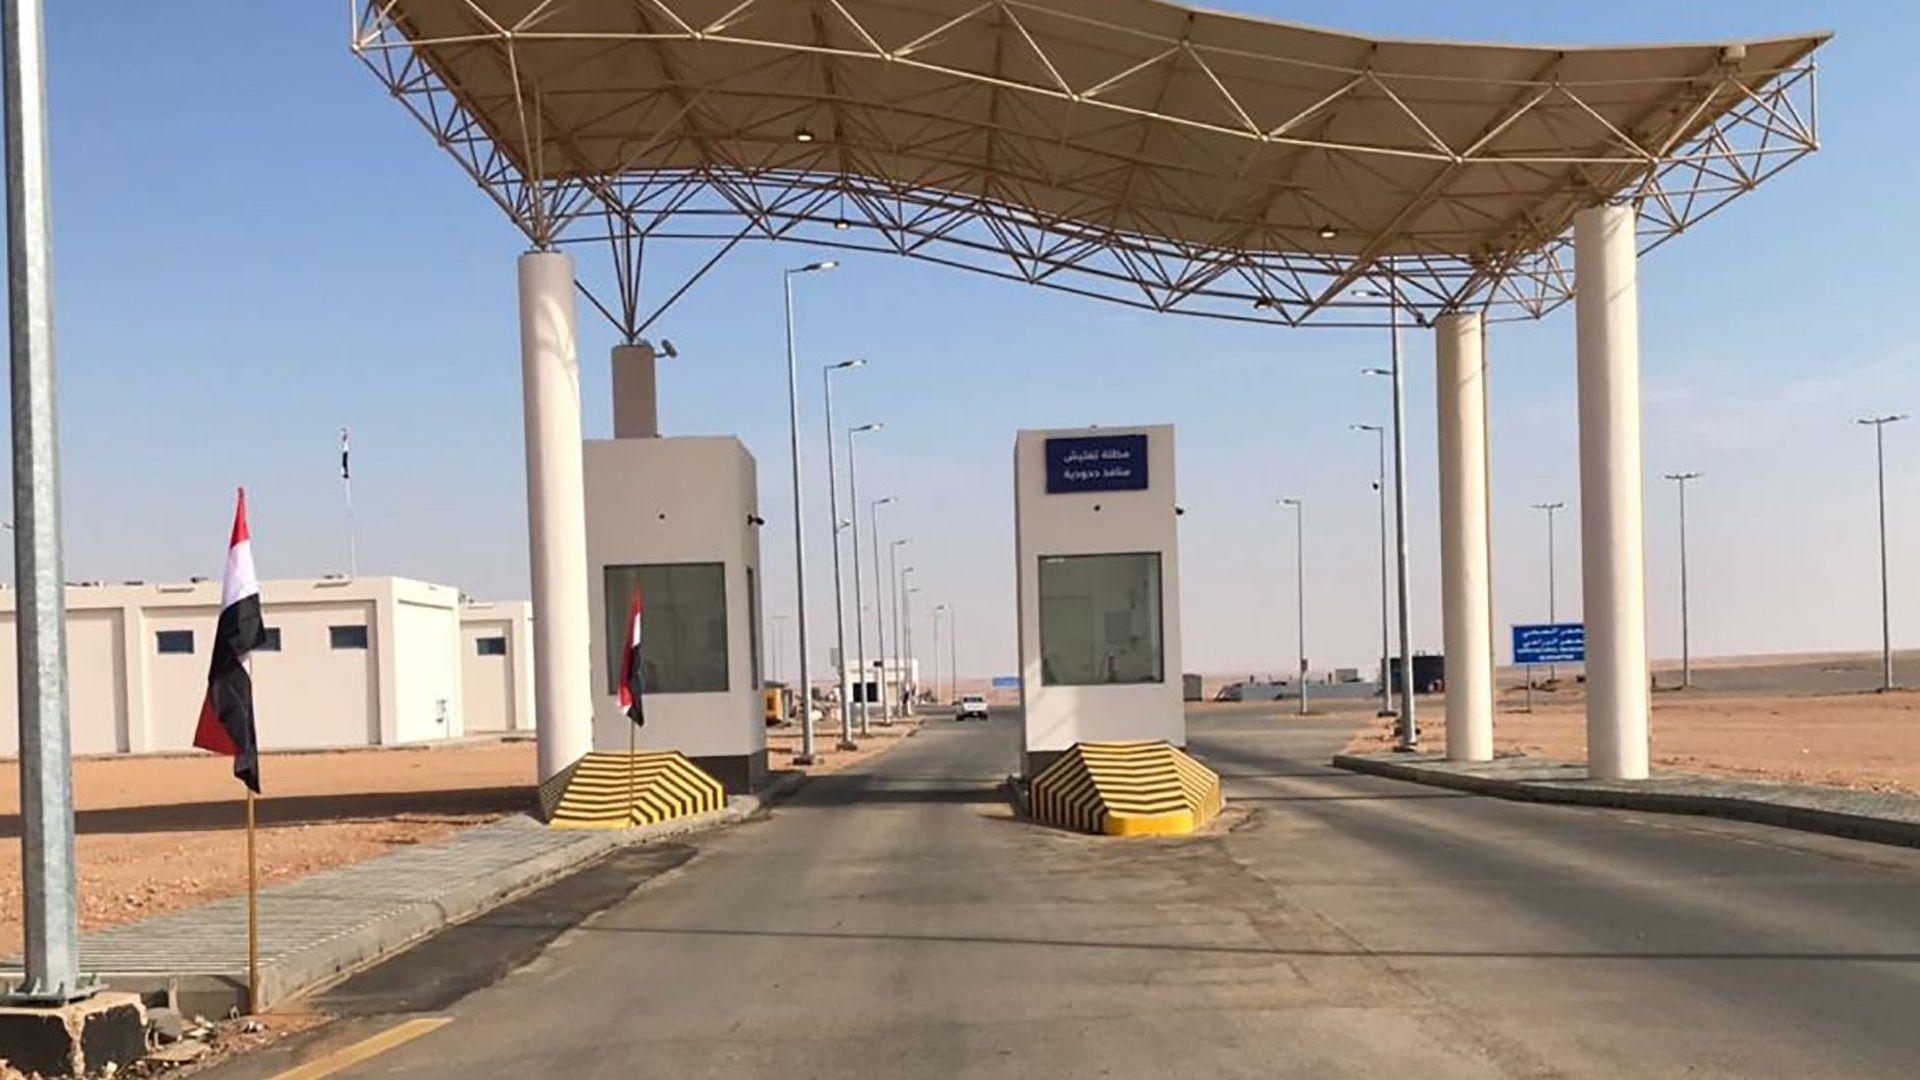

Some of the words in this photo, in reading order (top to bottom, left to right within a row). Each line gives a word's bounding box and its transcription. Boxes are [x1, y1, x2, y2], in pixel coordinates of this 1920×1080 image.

[1064, 449, 1098, 463] تفتيش
[1064, 470, 1101, 481] حدودية
[1103, 467, 1130, 477] منافذ
